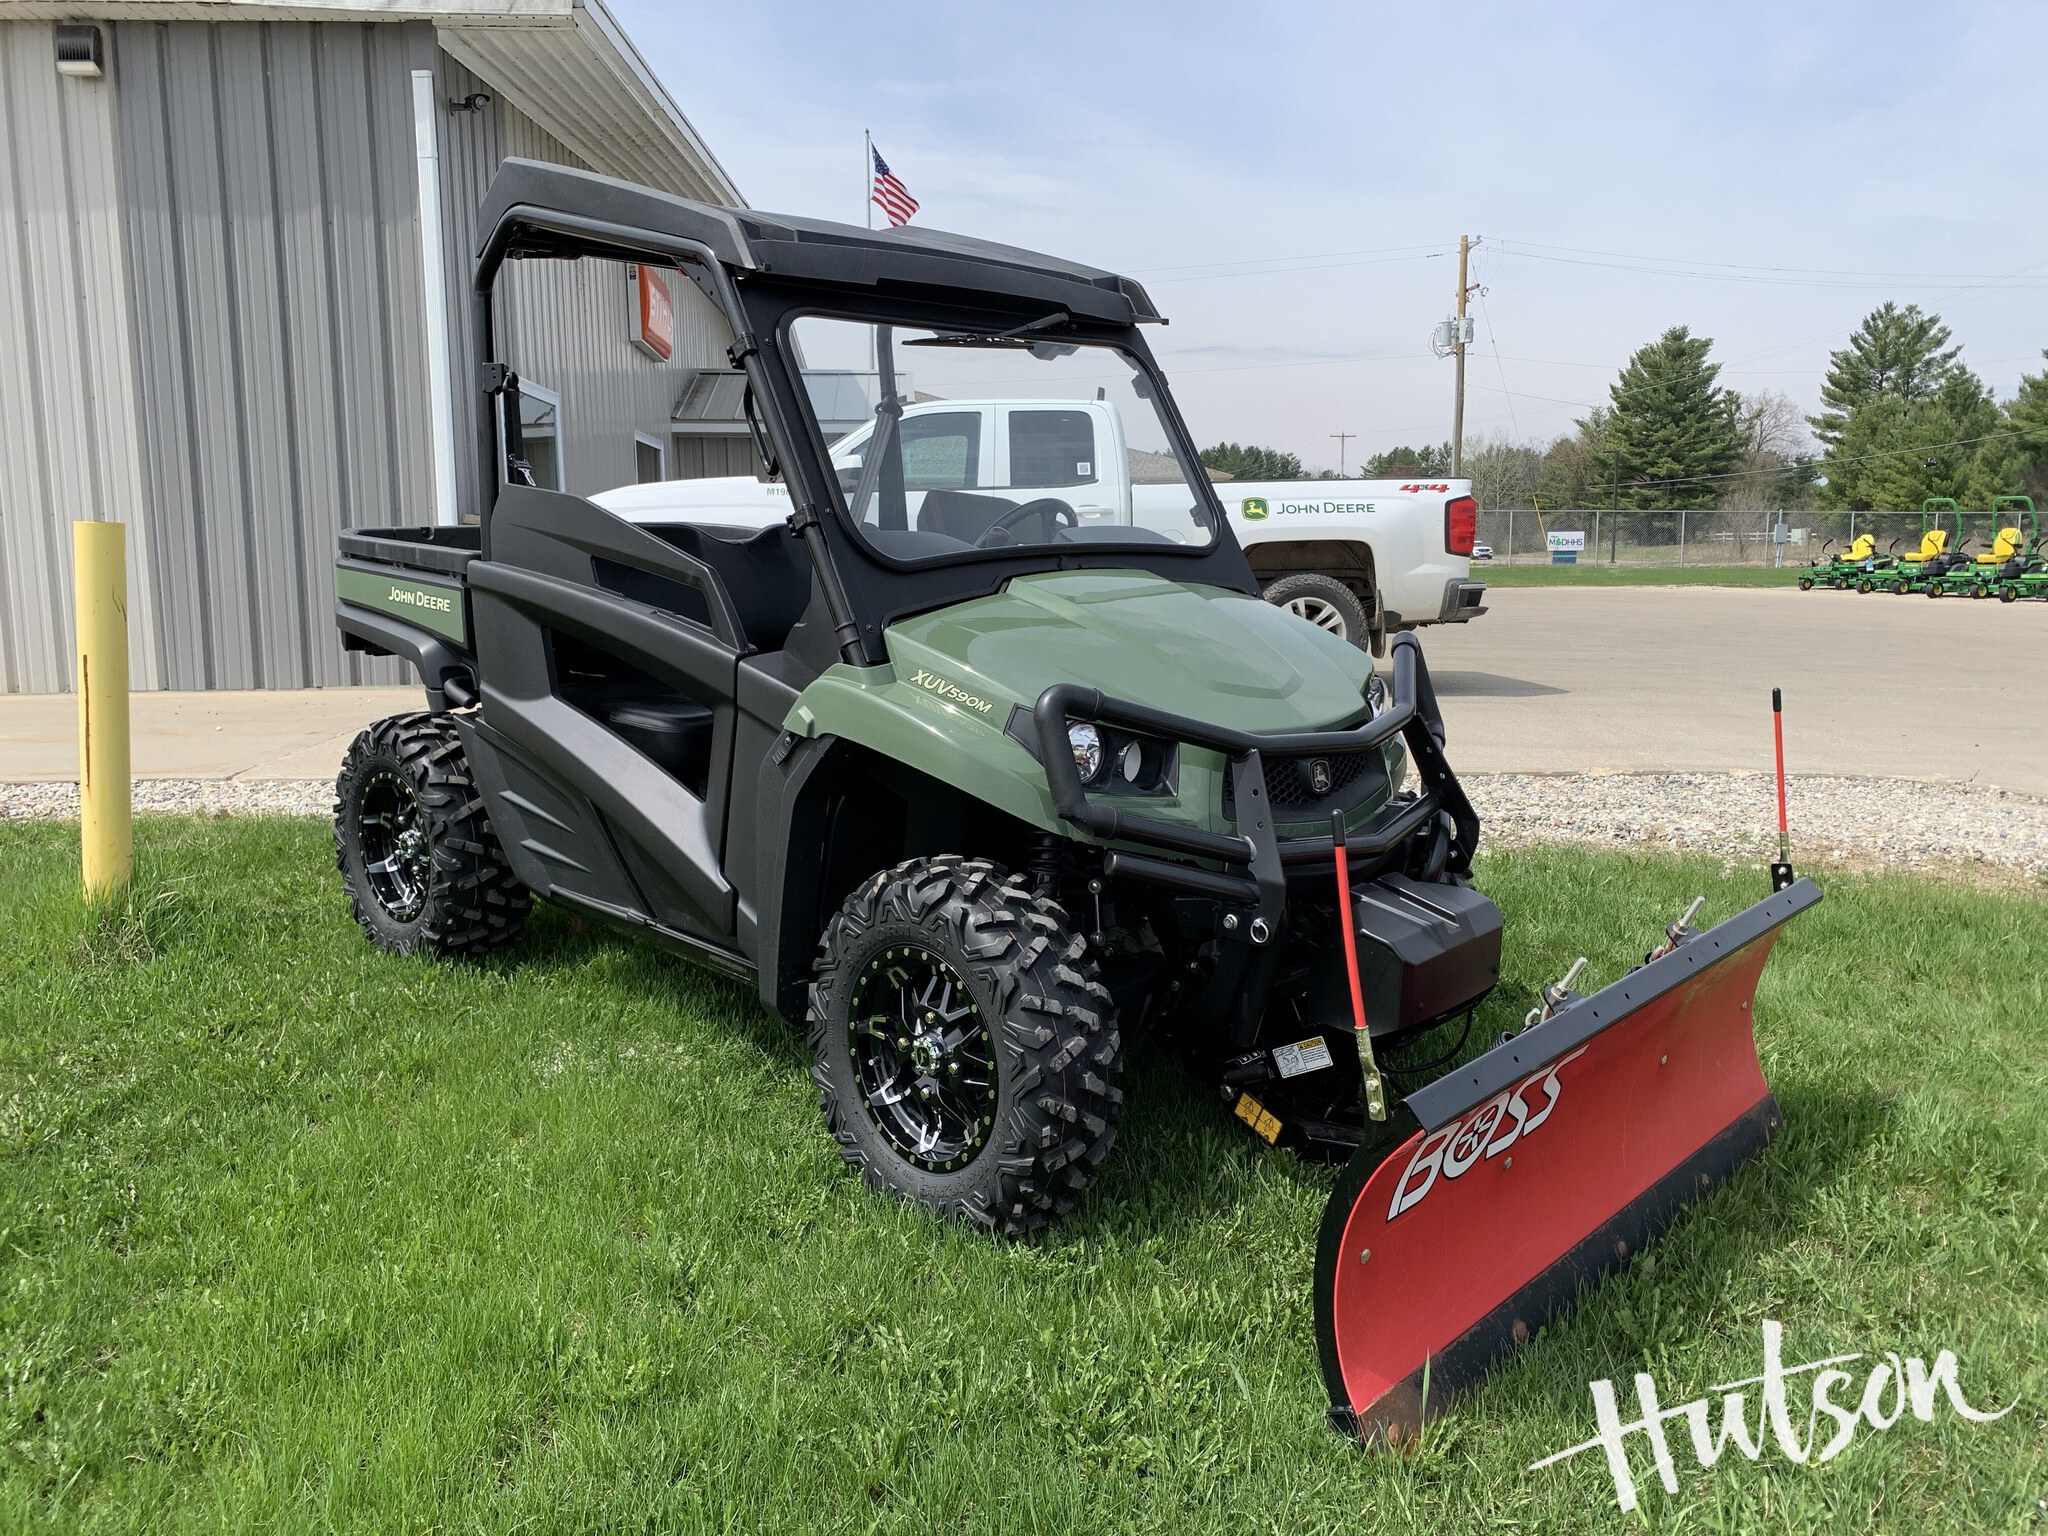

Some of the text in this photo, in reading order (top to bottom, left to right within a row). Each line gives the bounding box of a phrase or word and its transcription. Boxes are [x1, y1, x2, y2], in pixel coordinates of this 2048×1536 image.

[1277, 502, 1376, 515] JOHN DEERE
[388, 586, 451, 612] JOHN DEERE
[909, 668, 993, 713] XUV590M
[1386, 1044, 1591, 1224] BOSS
